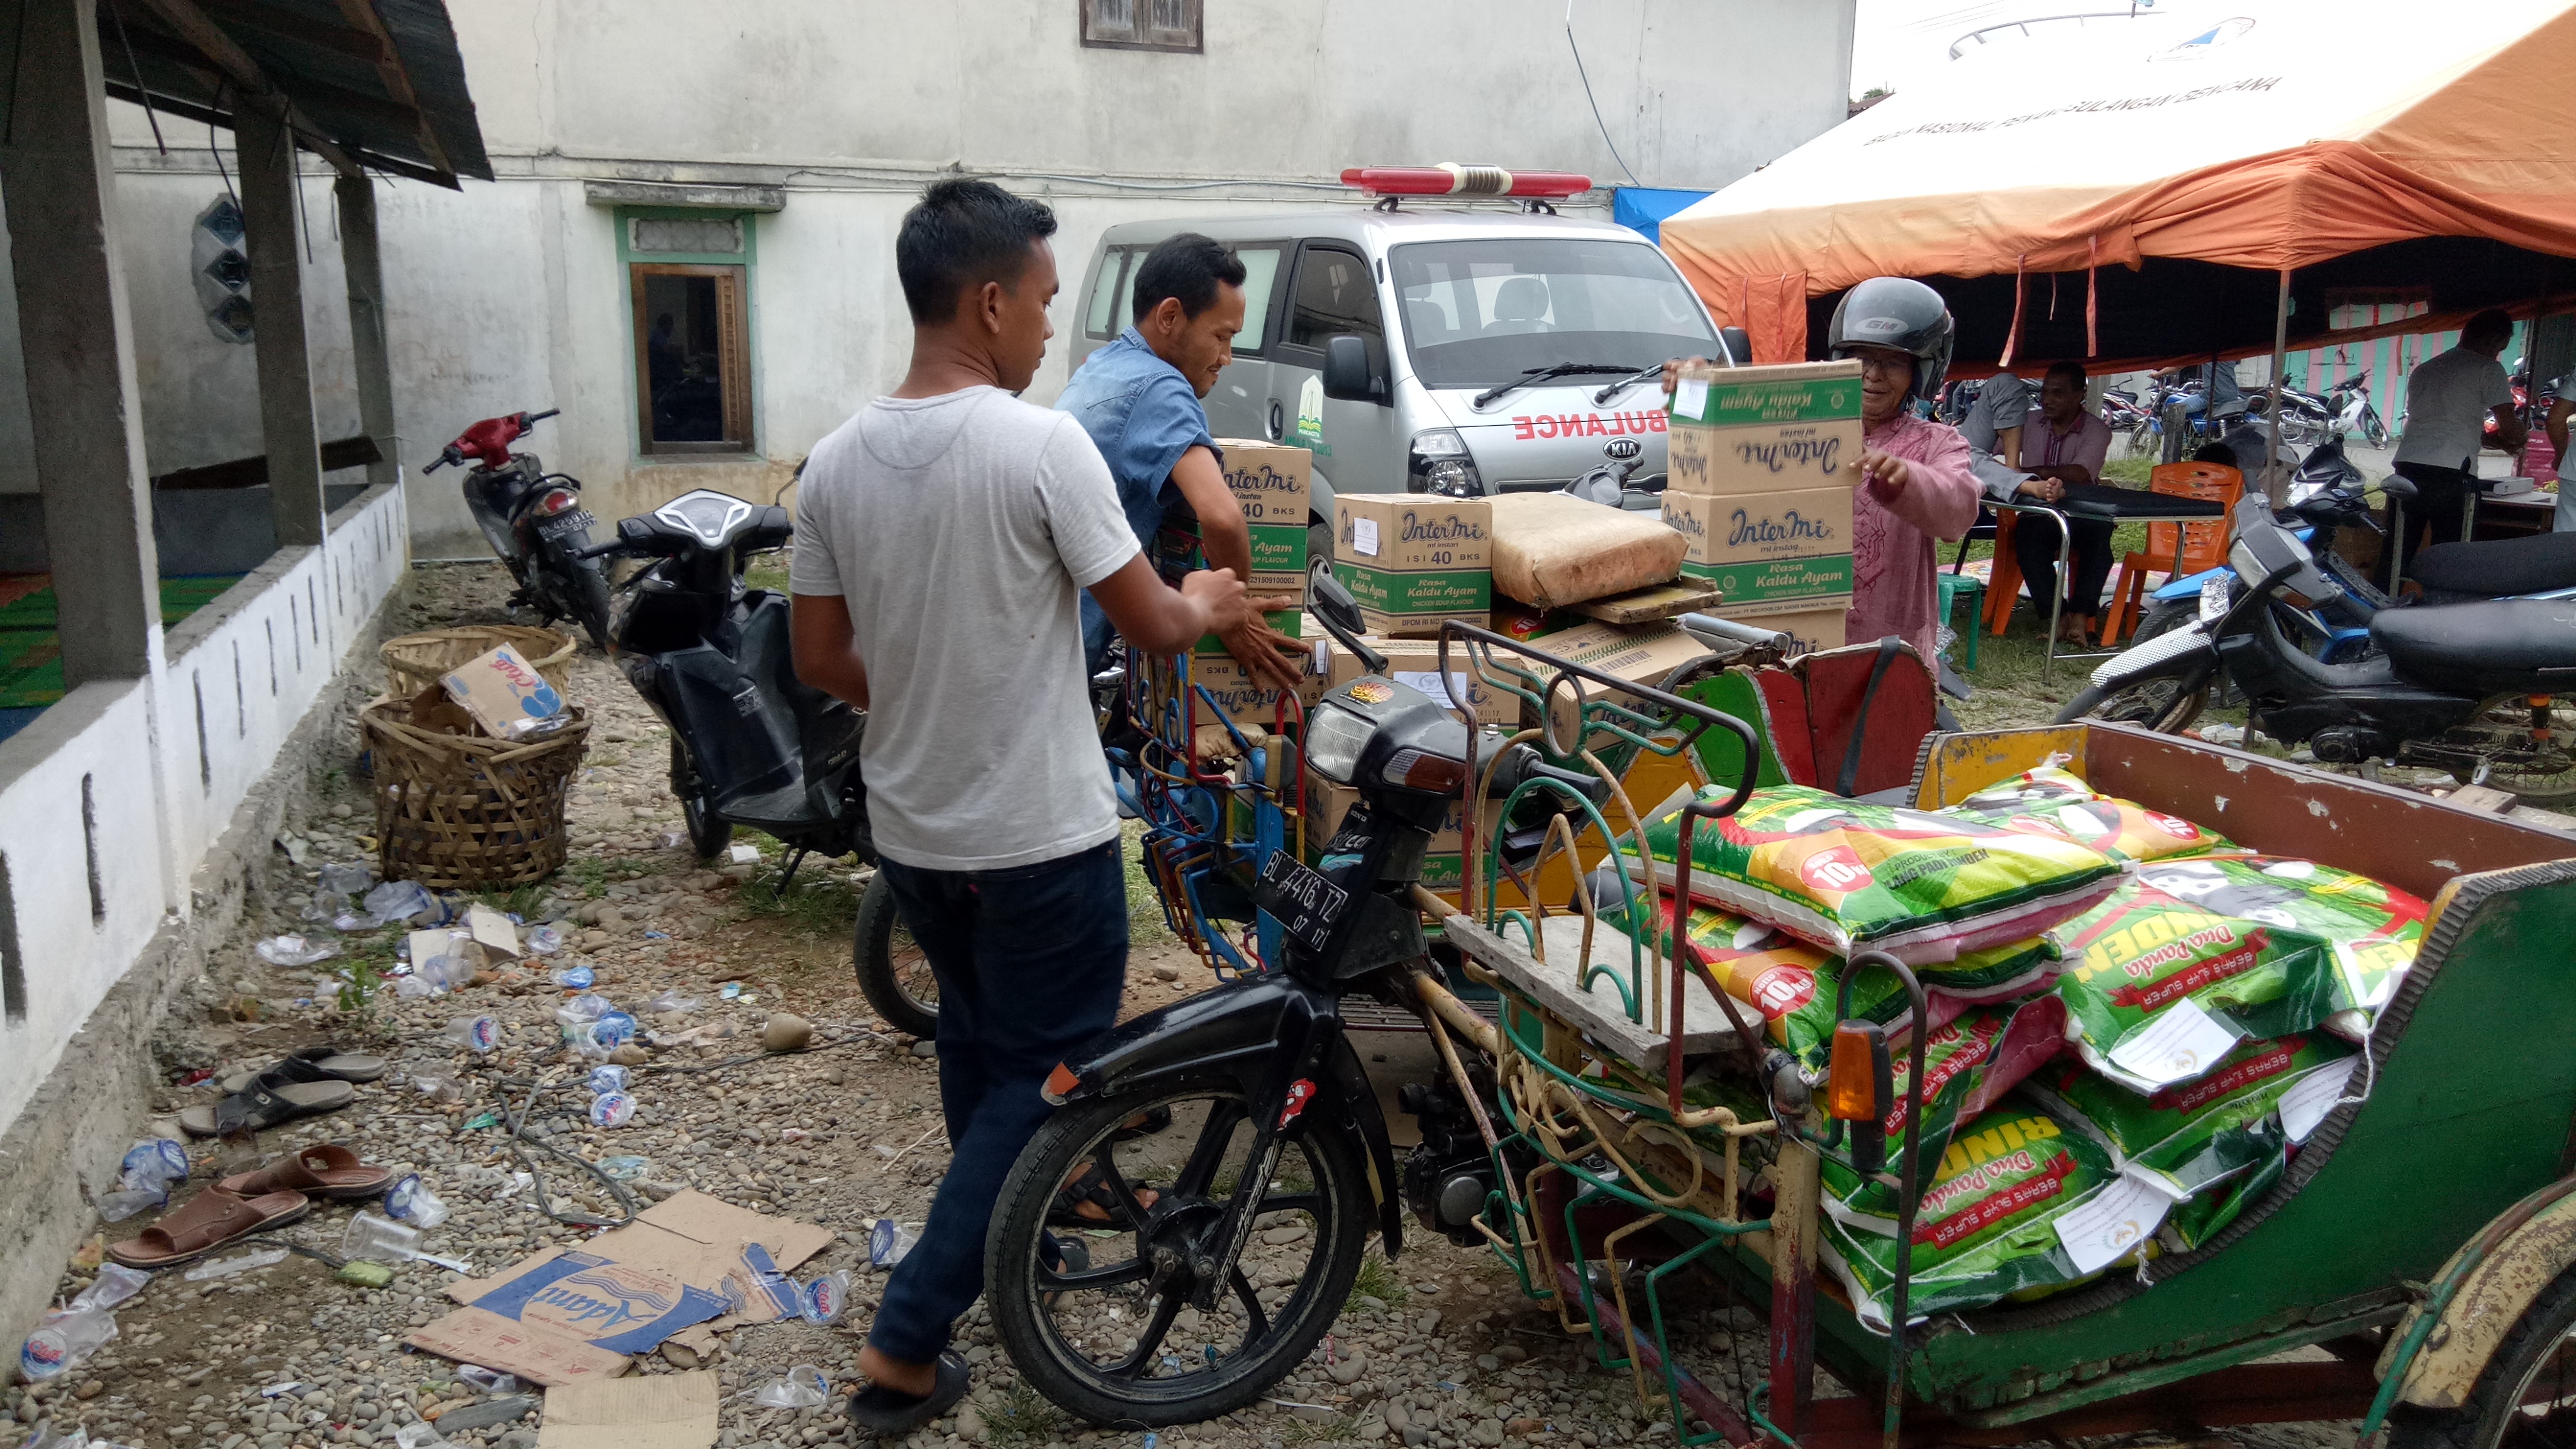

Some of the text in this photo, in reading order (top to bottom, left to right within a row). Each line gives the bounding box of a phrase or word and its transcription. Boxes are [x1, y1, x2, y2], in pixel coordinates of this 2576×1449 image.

[1865, 320, 1899, 331] GM
[1611, 443, 1636, 456] KIA
[1239, 492, 1262, 500] instan
[1242, 503, 1263, 518] 40
[1400, 509, 1485, 543] InterMi
[1663, 504, 1706, 538] InterMi
[1727, 508, 1833, 548] InterMi
[1255, 541, 1292, 555] Ayam
[1431, 551, 1452, 564] 40
[1357, 570, 1371, 581] Rasa
[1770, 562, 1803, 573] Rasa
[1756, 570, 1842, 587] Kaldu Ayam
[1351, 580, 1387, 599] Kaldu Ayam
[1407, 587, 1477, 597] Kaldu Ayam
[1517, 619, 1538, 630] 10
[1813, 862, 1856, 887] 10
[1921, 859, 1947, 876] PADI
[1262, 851, 1341, 923] BL 4416 TZ
[1293, 914, 1308, 933] 07
[2123, 924, 2236, 978] Dua Panda
[2213, 952, 2253, 973] BERAS
[1761, 978, 1812, 1011] 10 kg
[2143, 980, 2183, 1005] SUPER
[1948, 1042, 1987, 1074] BERAS
[2246, 1053, 2289, 1076] BERAS
[2180, 1082, 2217, 1108] SUPER
[1919, 1150, 2036, 1213] Dua Panda
[1936, 1178, 2057, 1241] BERAS SLYP SUPER
